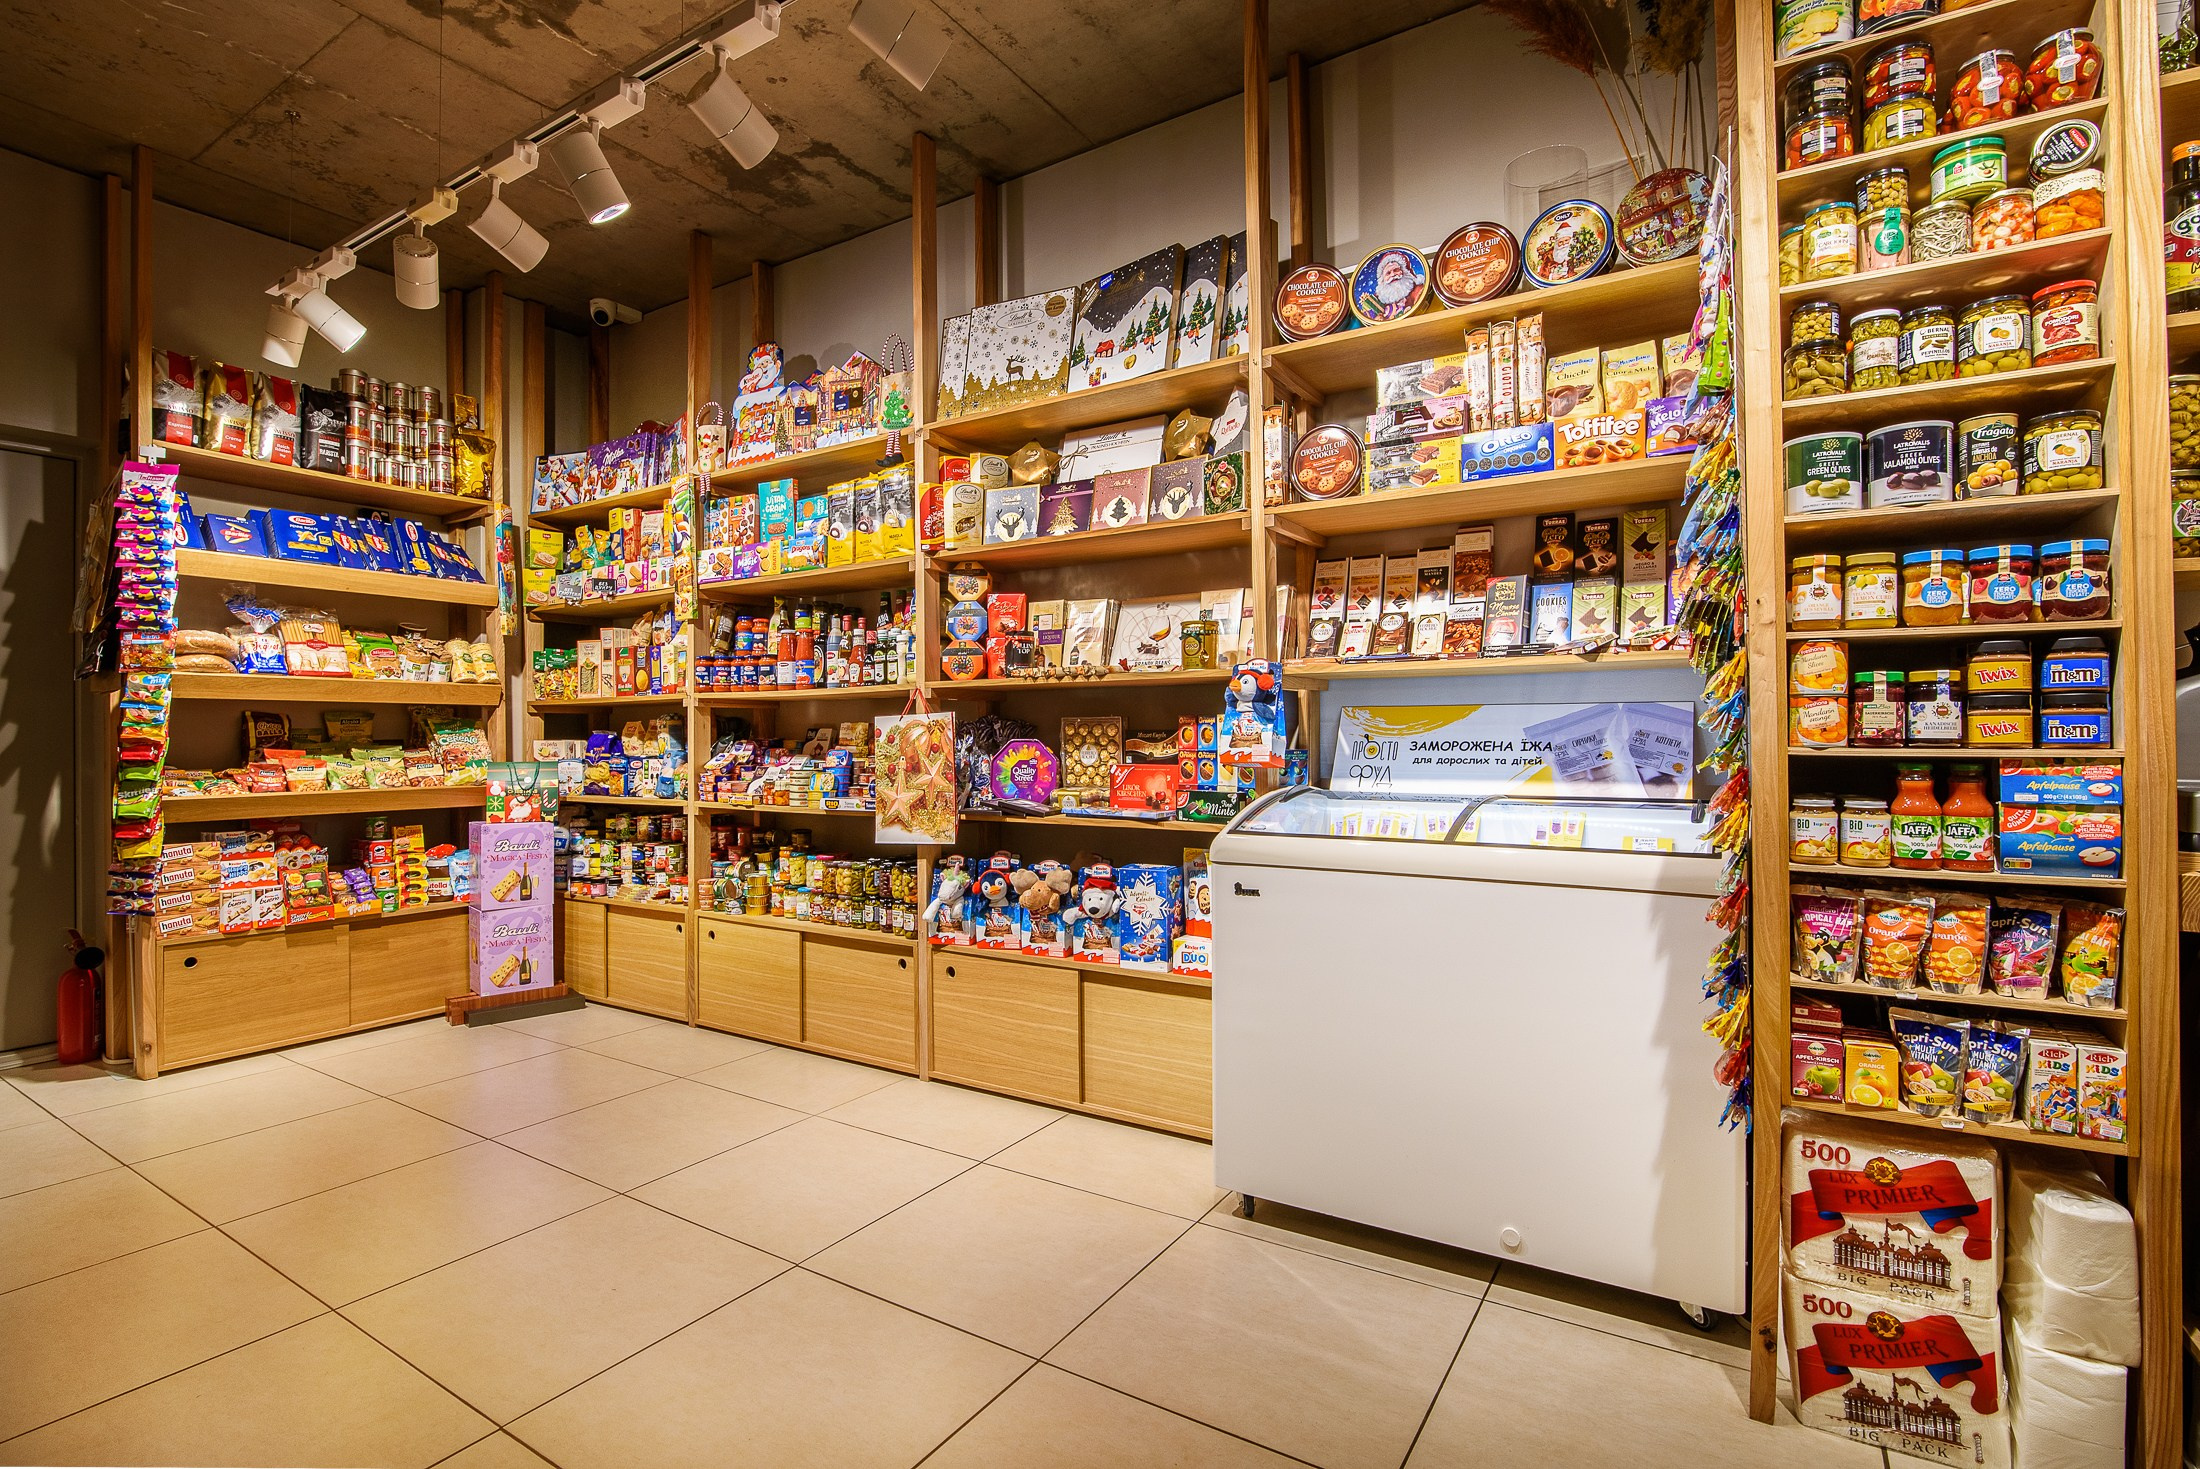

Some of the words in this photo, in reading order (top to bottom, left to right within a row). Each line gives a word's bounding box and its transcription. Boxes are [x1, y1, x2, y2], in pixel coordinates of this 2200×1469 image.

[1555, 212, 1572, 221] ONLY
[1446, 241, 1484, 258] CHOCOLATE
[1485, 236, 1500, 247] CHIP
[1456, 246, 1491, 262] COOKIES
[1287, 281, 1322, 291] CHOCOLATE
[1322, 280, 1337, 289] CHIP
[1296, 288, 1327, 296] COOKIES
[2045, 314, 2079, 326] POMODORI
[1502, 366, 1511, 397] GIOTTO
[167, 421, 192, 430] Espresso
[1558, 415, 1640, 443] Toffifee
[1977, 427, 2014, 438] Fragata
[224, 435, 242, 443] Crema
[1482, 432, 1532, 454] OREO
[1893, 440, 1931, 449] LATROVALIS
[1300, 443, 1333, 457] CHOCOLATE
[1334, 440, 1348, 448] CHIP
[1310, 449, 1339, 460] COOKIES
[604, 449, 624, 465] Milka
[1884, 458, 1917, 469] KALAMON
[1918, 455, 1941, 464] OLIVES
[1972, 452, 1997, 462] ANCHOA
[1807, 466, 1830, 476] GREEN
[1831, 465, 1851, 473] OLIVES
[765, 502, 787, 513] GRAIN
[295, 517, 316, 525] Barilla
[1535, 596, 1567, 606] COOKIES
[1801, 646, 1825, 655] freshona
[1976, 667, 2019, 684] Twix
[1804, 700, 1828, 708] freshona
[1803, 708, 1835, 718] Mandarin
[1977, 721, 2020, 737] Twix
[1409, 741, 1513, 752] ЗАМОРОЖЕНА
[1521, 739, 1553, 752] ЇЖА
[1655, 735, 1682, 749] КОТЛЕТИ
[1436, 758, 1490, 766] дорослих
[1511, 757, 1542, 766] дітей
[1012, 767, 1036, 776] Quality
[1015, 773, 1034, 782] Street
[2026, 781, 2081, 791] Apfelpause
[1117, 790, 1147, 798] KIRSCHEN
[1206, 802, 1237, 817] Mints
[1902, 825, 1933, 835] JAFFA
[1947, 826, 1977, 836] JAFFA
[494, 839, 540, 852] Bauli
[2018, 842, 2076, 852] Apfelpause
[163, 847, 192, 859] hanuta
[487, 854, 522, 863] MAGICA
[163, 870, 193, 883] hanuta
[160, 894, 191, 906] hanuta
[348, 903, 371, 915] Trolli
[161, 918, 191, 930] hanuta
[493, 923, 539, 938] Bauli
[1869, 926, 1907, 938] Orange
[486, 939, 522, 948] MAGICA
[522, 936, 548, 944] FESTA
[1183, 953, 1207, 963] DUO
[1898, 1032, 1958, 1054] Capri-Sun
[1913, 1043, 1936, 1054] MULTI
[1795, 1054, 1840, 1064] APFEL-KIRSCH
[1911, 1051, 1939, 1063] VITAMIN
[2042, 1050, 2065, 1059] Rich
[2089, 1054, 2115, 1063] Rich
[1858, 1062, 1885, 1070] ORANGE
[1800, 1140, 1851, 1165] 500
[1829, 1172, 1858, 1184] LUX
[1844, 1184, 1946, 1210] PRIMIER
[1837, 1272, 1868, 1286] BIG
[1890, 1282, 1936, 1300] PACK
[1803, 1294, 1853, 1318] 500
[1833, 1327, 1863, 1339] LUX
[1849, 1339, 1949, 1365] PRIMIER
[1849, 1427, 1880, 1442] BIG
[1902, 1438, 1950, 1458] PACK
